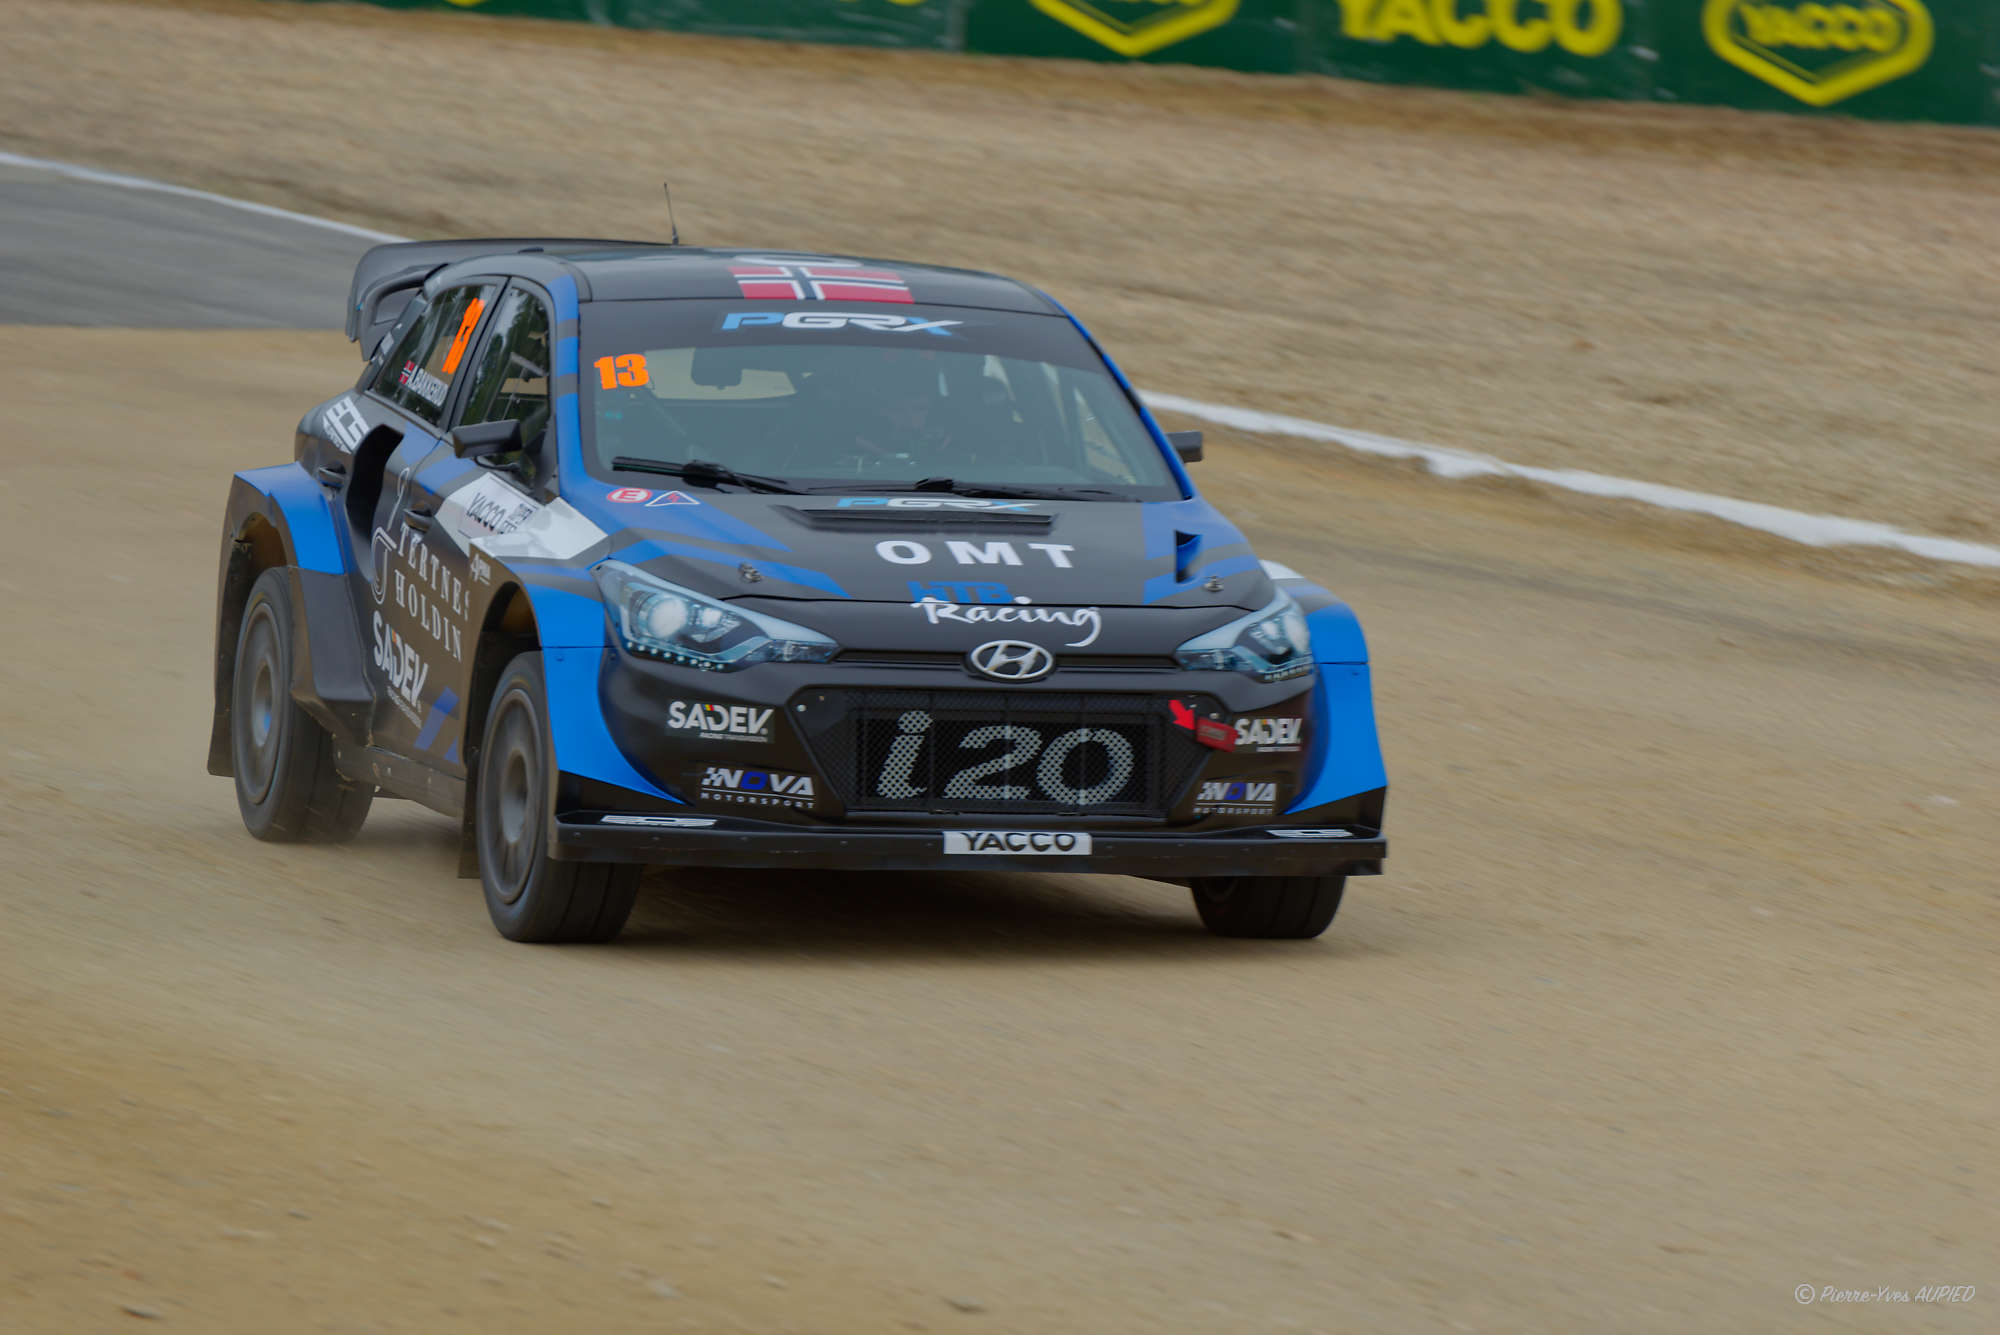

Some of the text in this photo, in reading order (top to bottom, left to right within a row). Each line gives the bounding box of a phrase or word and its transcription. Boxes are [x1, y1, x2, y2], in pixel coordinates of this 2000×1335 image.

[1340, 0, 1622, 57] YACCO
[1738, 2, 1900, 51] YACCO
[722, 312, 963, 335] PGRX
[594, 353, 649, 390] 13
[836, 498, 1040, 511] PGRX
[875, 541, 1076, 568] OMT
[910, 596, 1101, 647] Racing
[373, 610, 429, 712] SADEV
[667, 701, 774, 734] SADEV
[1234, 718, 1302, 745] SADEV
[877, 710, 1133, 805] i20
[960, 832, 1076, 851] YACCO
